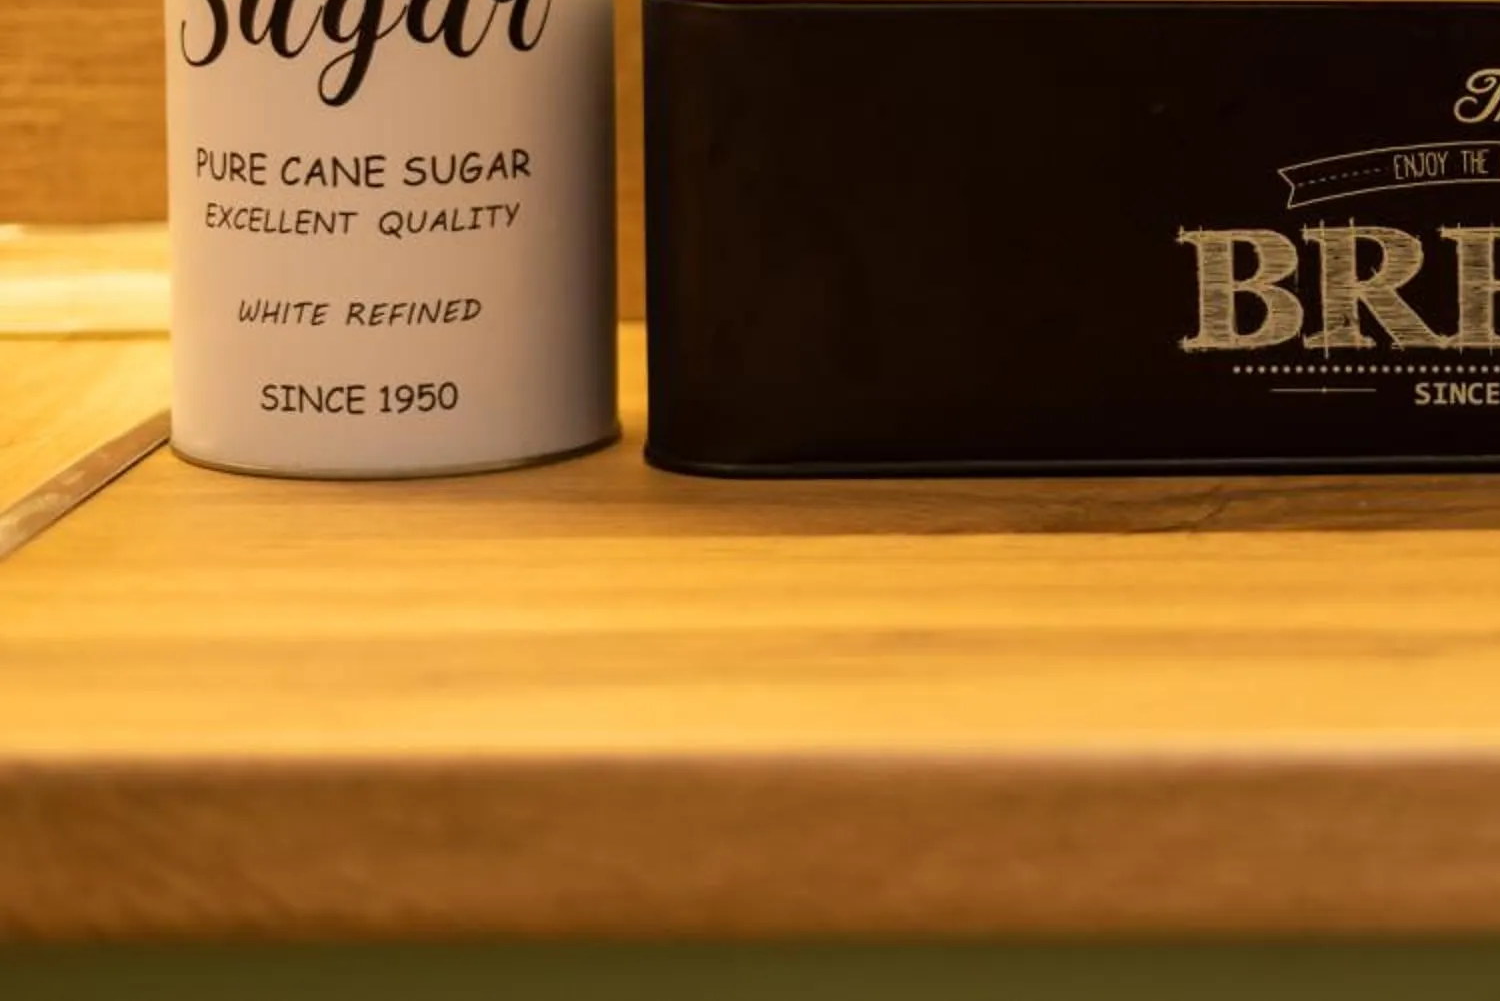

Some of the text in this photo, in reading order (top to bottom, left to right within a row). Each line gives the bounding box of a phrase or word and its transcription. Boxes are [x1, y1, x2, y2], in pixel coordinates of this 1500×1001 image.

[197, 147, 531, 187] PURE CANE SUGAR
[1393, 151, 1449, 180] ENJOY
[1461, 150, 1490, 175] THE
[206, 203, 520, 238] EXCELLENT QUALITY
[238, 299, 482, 326] WHITE REFINED
[260, 382, 459, 414] SINCE 1950
[1415, 381, 1500, 405] SINCE
